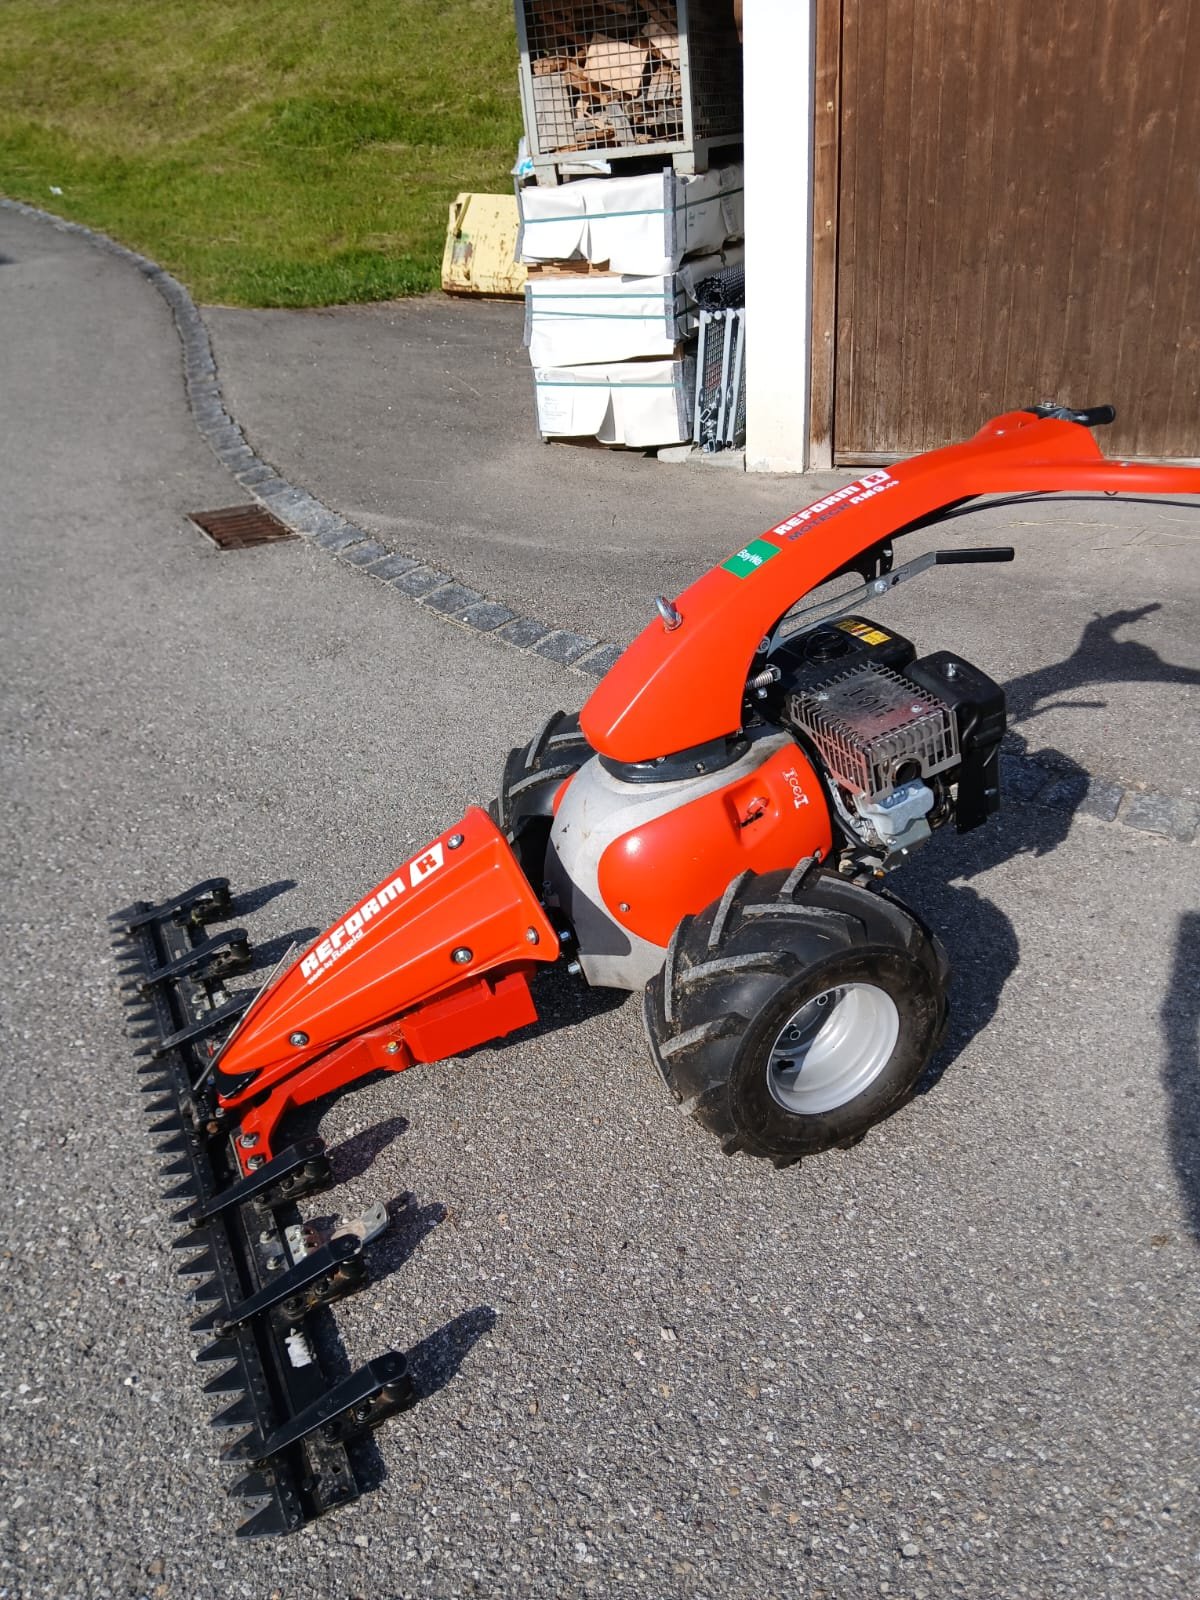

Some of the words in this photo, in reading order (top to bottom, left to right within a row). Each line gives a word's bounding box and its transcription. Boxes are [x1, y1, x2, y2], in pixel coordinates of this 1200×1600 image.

[772, 485, 861, 536] REFORM
[788, 503, 850, 541] MOTECH
[300, 877, 406, 978] REFORM
[331, 928, 363, 961] Rapid
